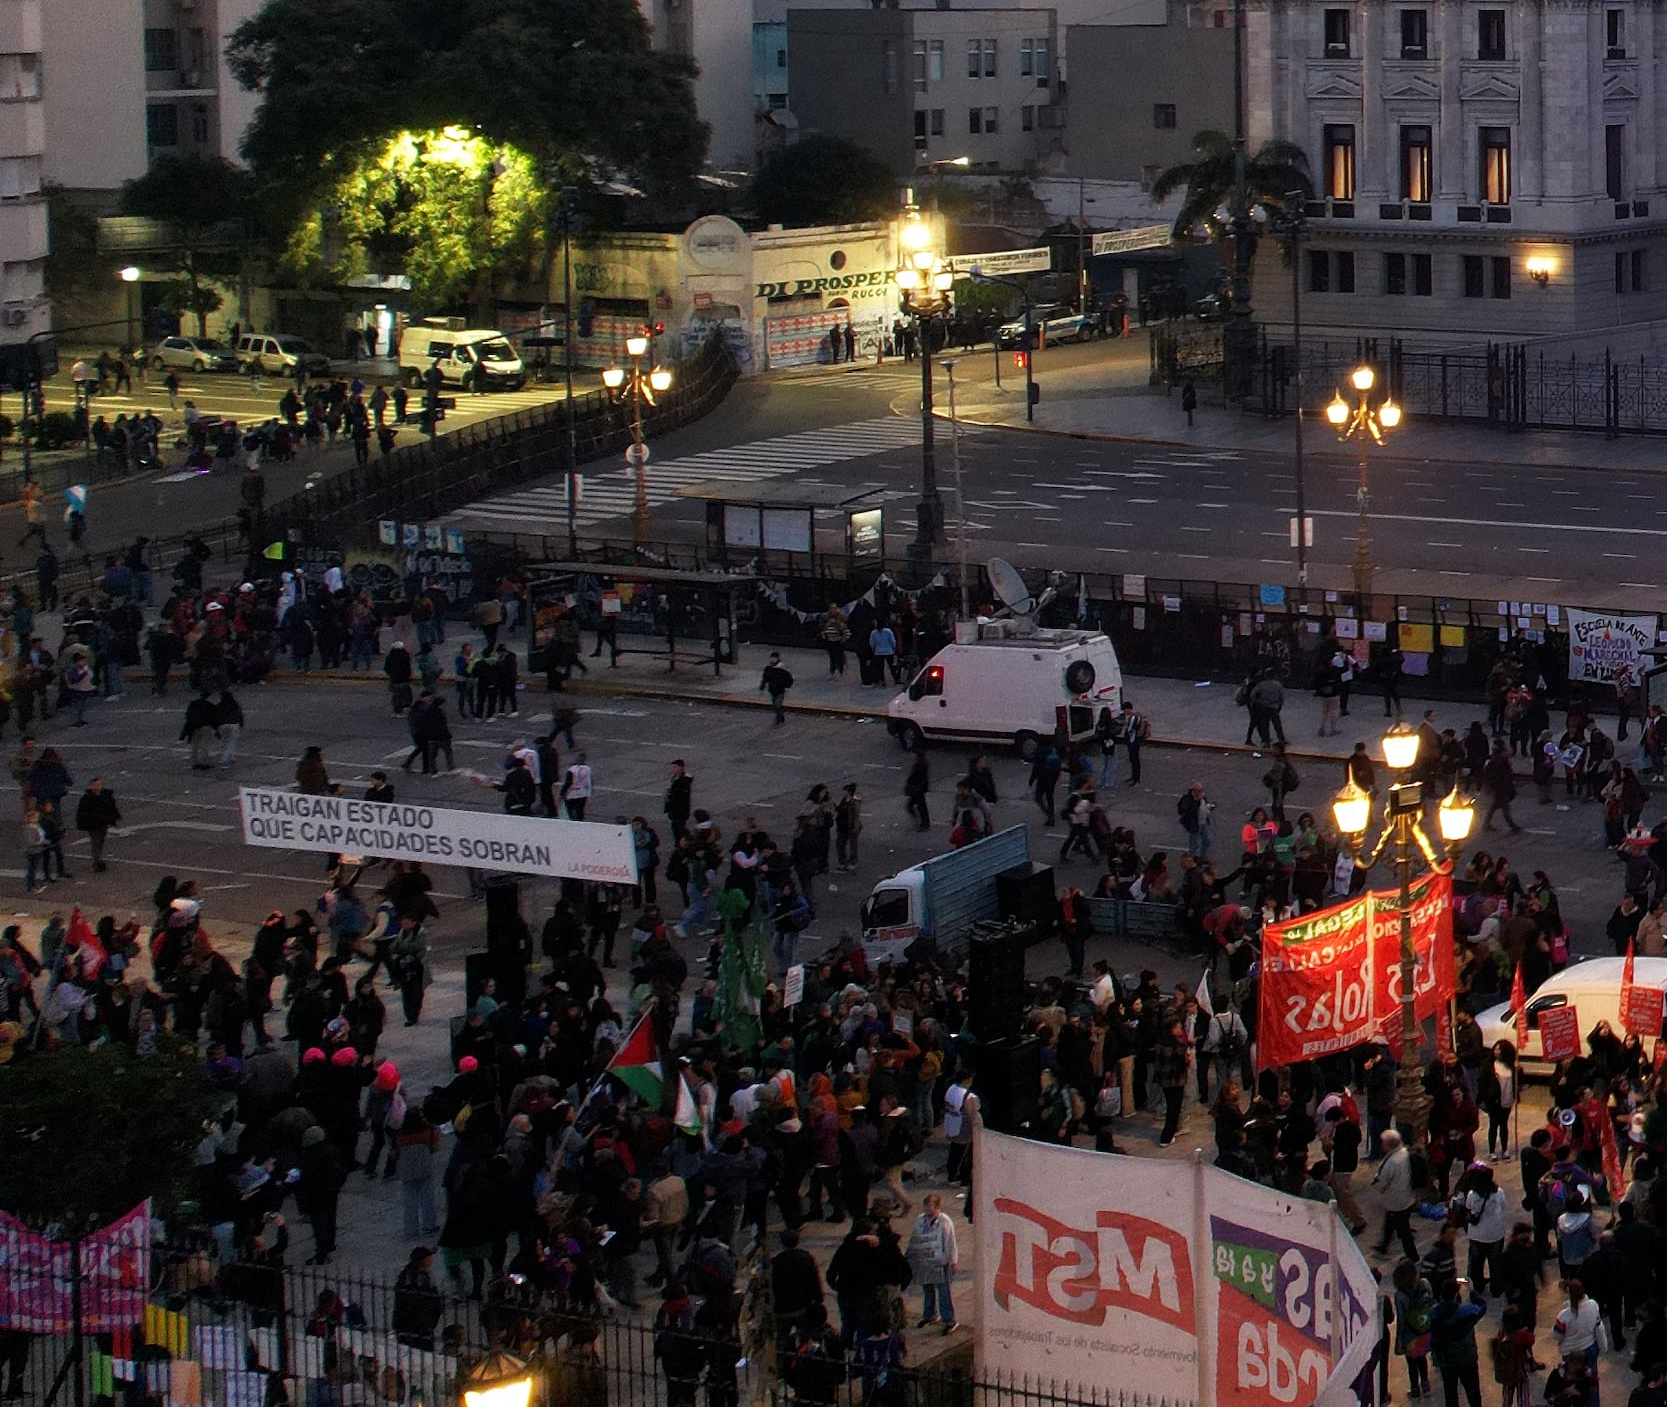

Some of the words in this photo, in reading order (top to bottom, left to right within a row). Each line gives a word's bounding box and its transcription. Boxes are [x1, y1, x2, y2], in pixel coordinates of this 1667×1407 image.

[755, 281, 788, 298] DI
[247, 792, 340, 820] TRAIGAN
[348, 802, 433, 829] ESTADO
[250, 816, 292, 840] QUE
[301, 821, 453, 856] CAPACIDADES
[458, 838, 551, 866] SOBRAN
[569, 864, 581, 873] LA
[582, 864, 631, 877] PODEROSA
